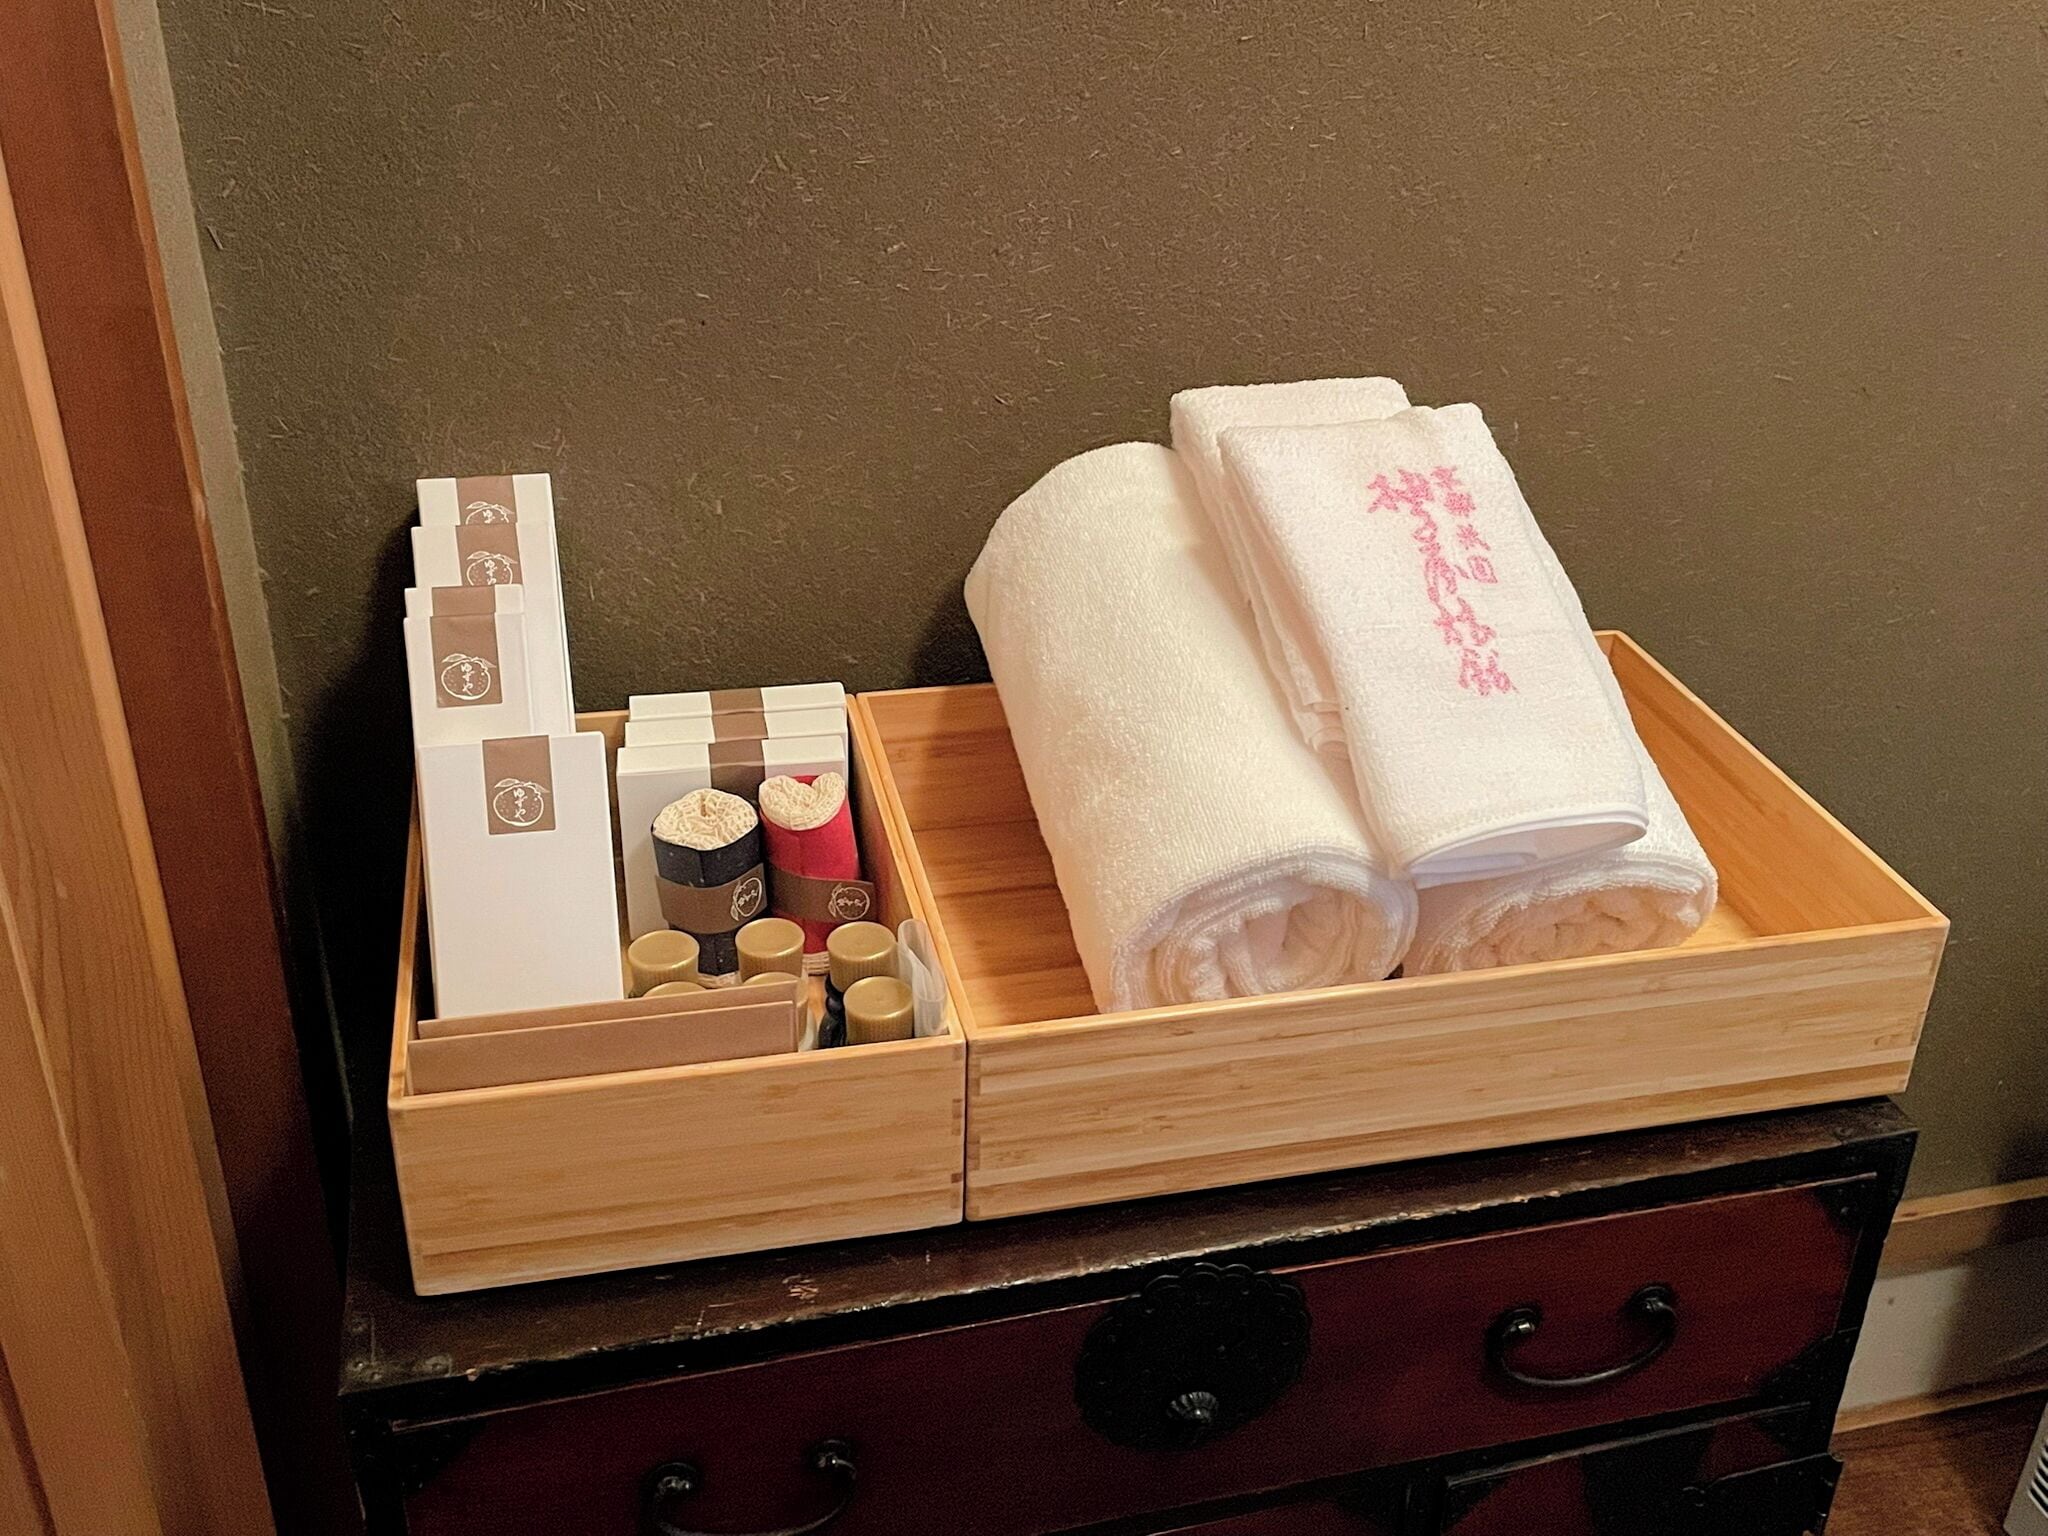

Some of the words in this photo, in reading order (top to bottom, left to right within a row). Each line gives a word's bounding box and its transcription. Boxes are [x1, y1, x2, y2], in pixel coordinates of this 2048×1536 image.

[1366, 468, 1519, 696] 柚子屋旅館
[460, 662, 475, 696] ゆずや
[512, 787, 528, 822] ゆずや
